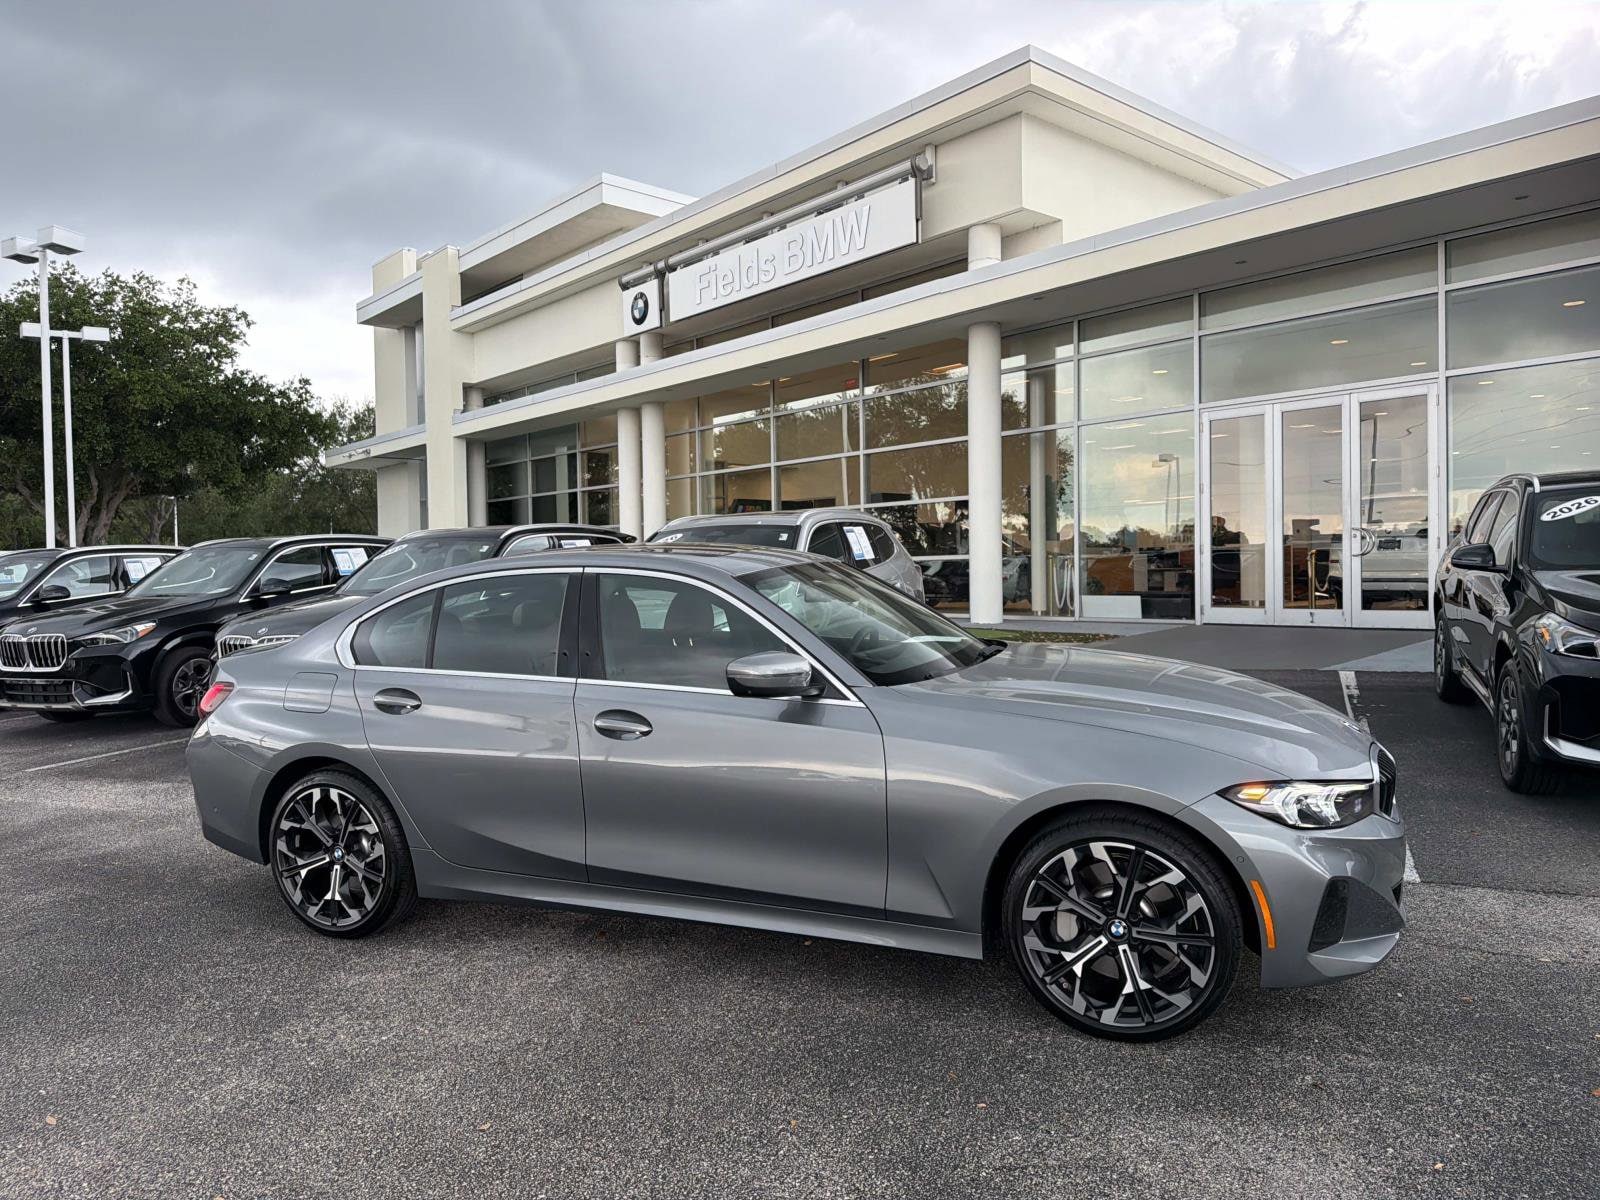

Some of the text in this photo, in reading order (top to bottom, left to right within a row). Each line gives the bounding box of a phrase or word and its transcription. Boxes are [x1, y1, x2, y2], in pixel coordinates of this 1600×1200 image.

[696, 204, 871, 305] Fields BMW
[1546, 498, 1598, 519] 2026
